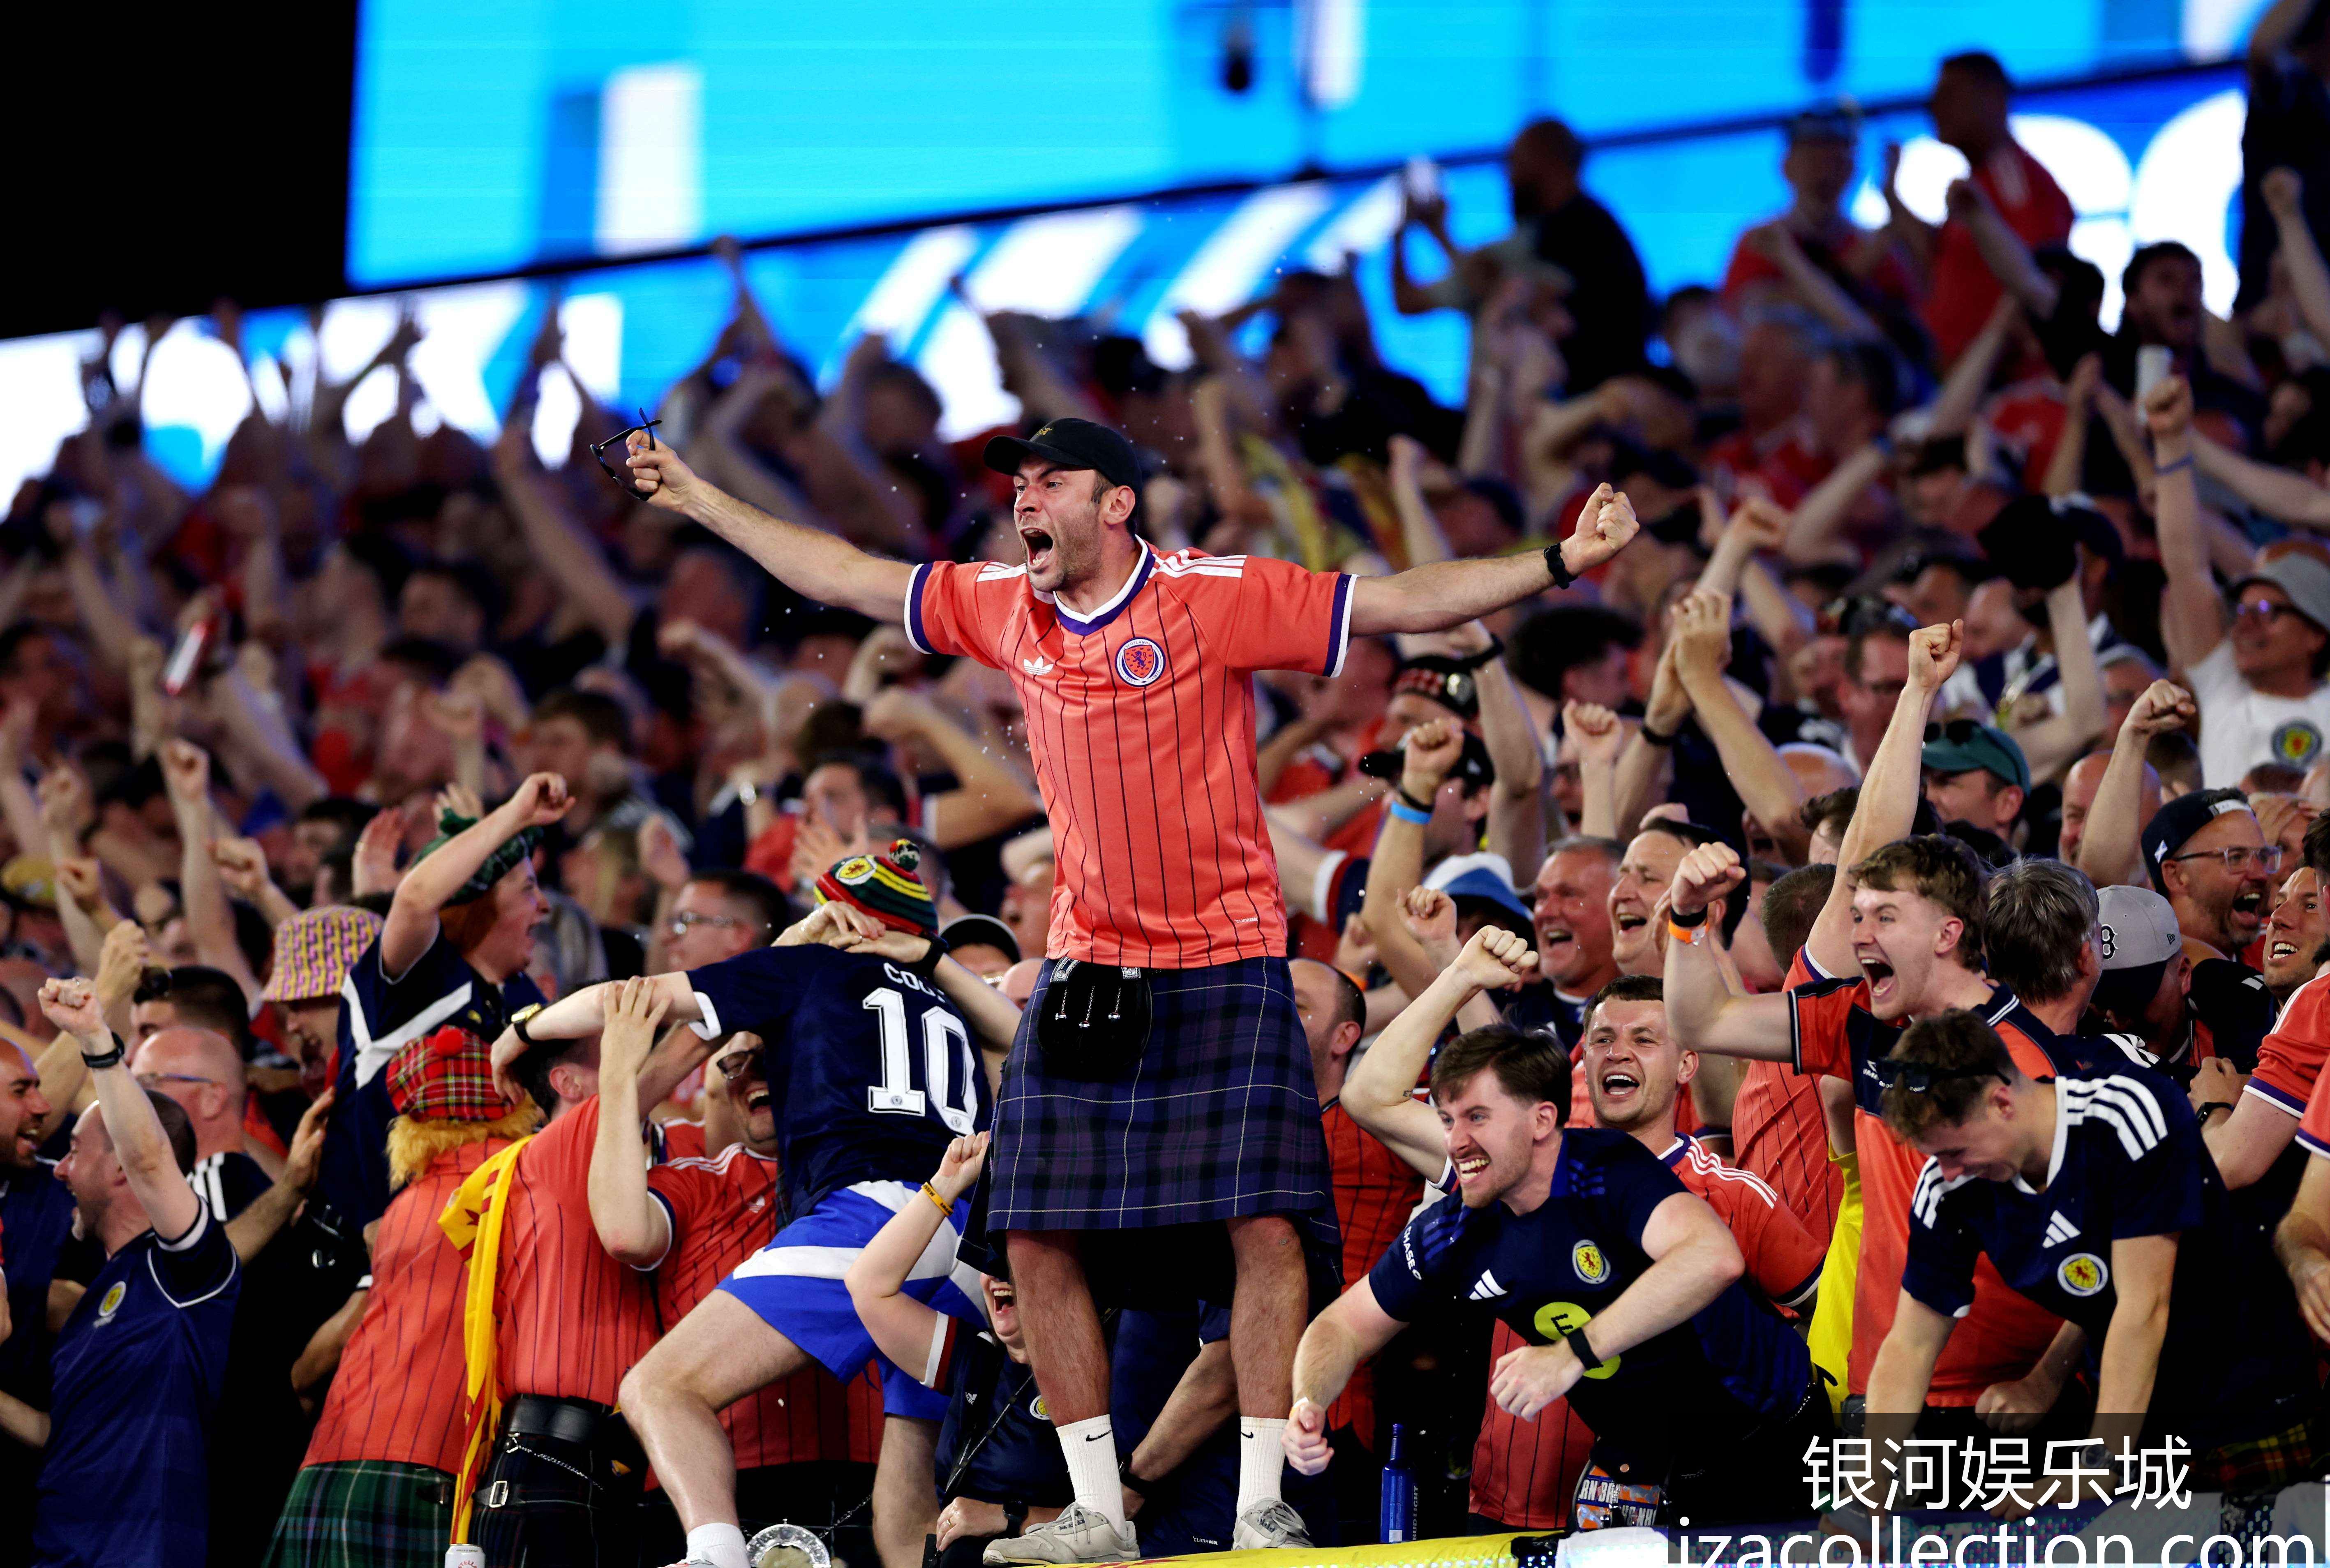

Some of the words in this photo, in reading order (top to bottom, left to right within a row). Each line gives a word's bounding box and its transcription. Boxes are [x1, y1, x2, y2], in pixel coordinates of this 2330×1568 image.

[2101, 924, 2118, 960] B
[863, 987, 978, 1138] 10
[1403, 1226, 1416, 1270] CHASE
